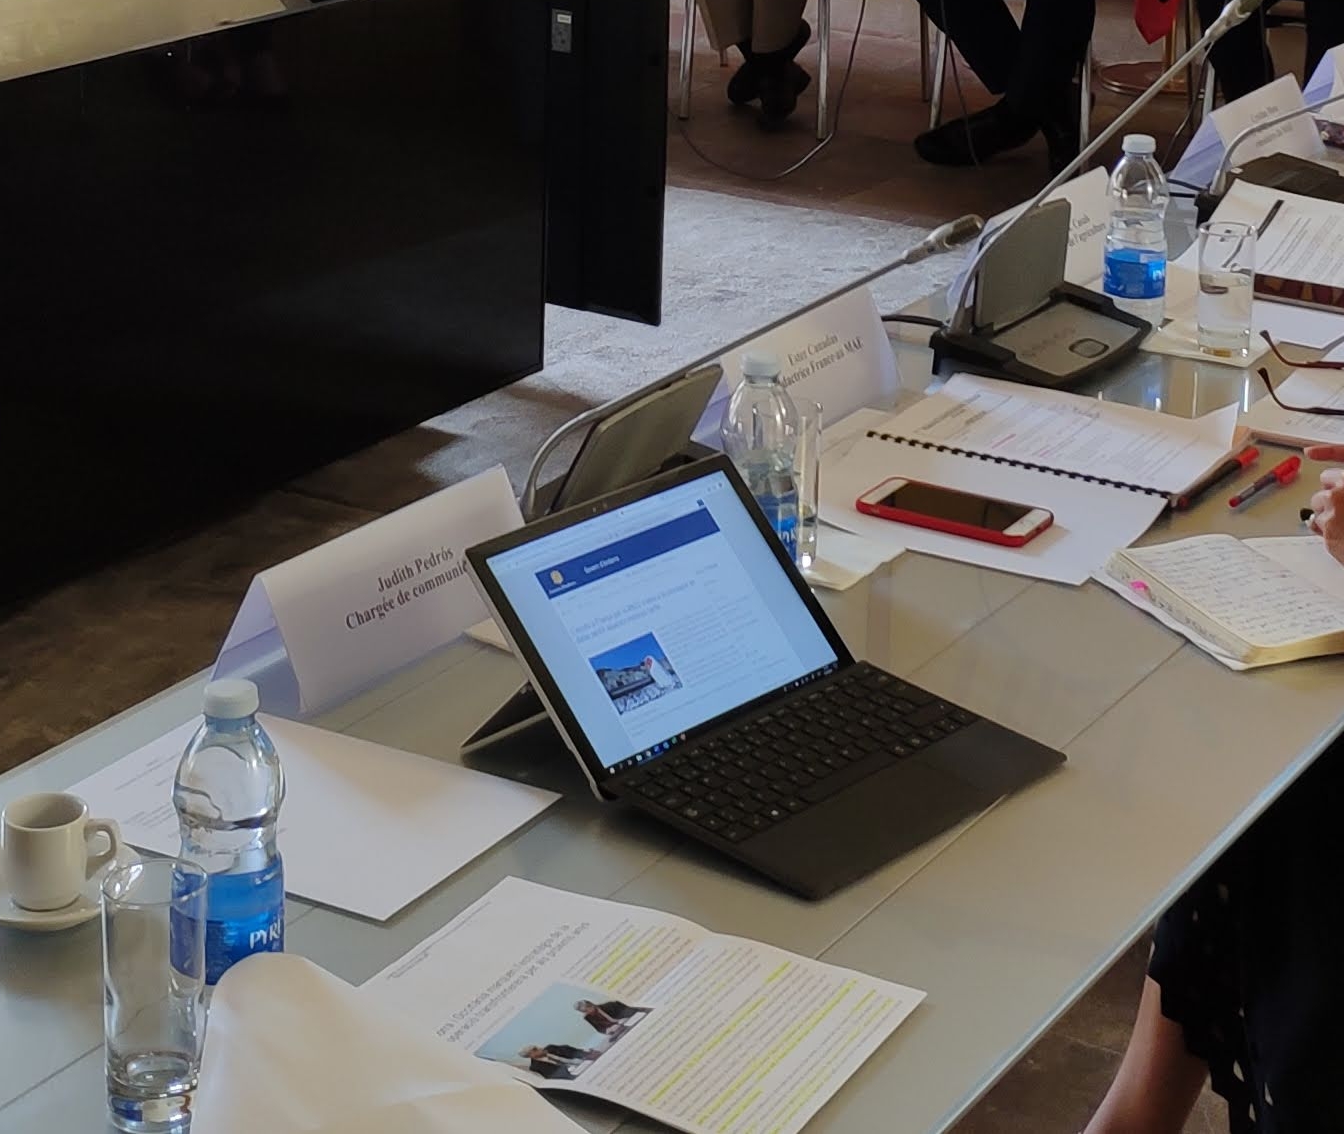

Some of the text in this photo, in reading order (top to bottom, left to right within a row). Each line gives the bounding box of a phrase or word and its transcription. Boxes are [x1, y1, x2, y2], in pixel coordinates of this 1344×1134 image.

[377, 546, 454, 593] Judith Pedrós
[345, 595, 396, 630] Chargée
[396, 588, 412, 606] de
